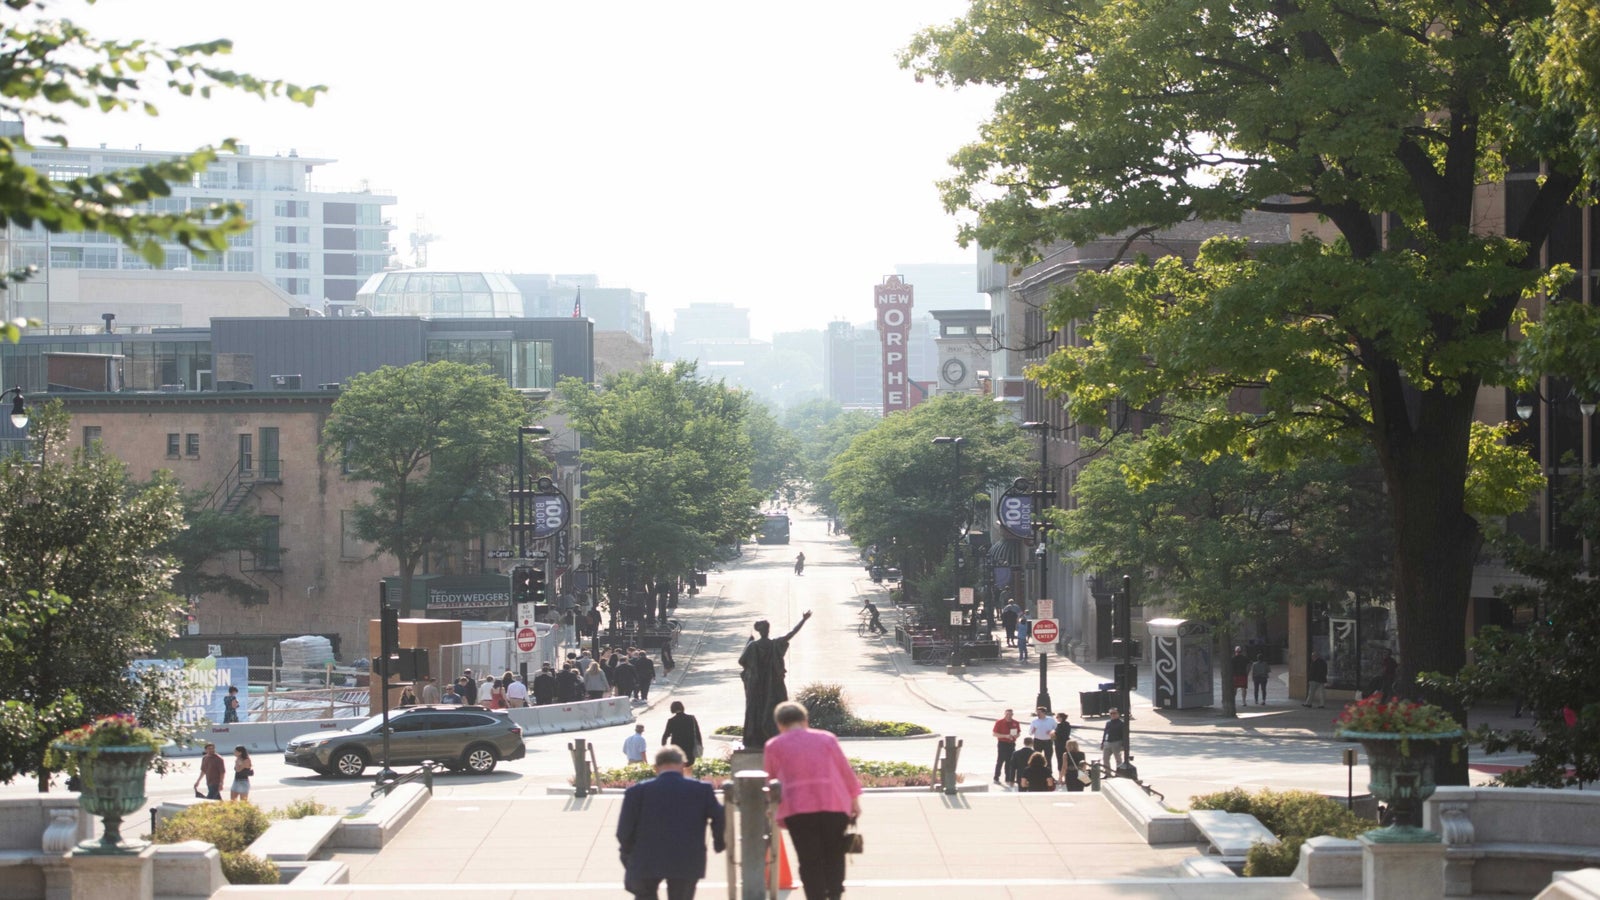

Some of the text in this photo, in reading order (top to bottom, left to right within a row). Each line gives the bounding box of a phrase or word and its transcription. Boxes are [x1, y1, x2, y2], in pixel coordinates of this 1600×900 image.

[878, 294, 909, 305] NEW
[884, 309, 905, 405] ORPHE
[535, 502, 546, 529] BLOCK
[545, 497, 562, 528] 100
[1005, 497, 1021, 528] 100
[1021, 503, 1031, 529] BLOCK
[952, 617, 961, 625] 15
